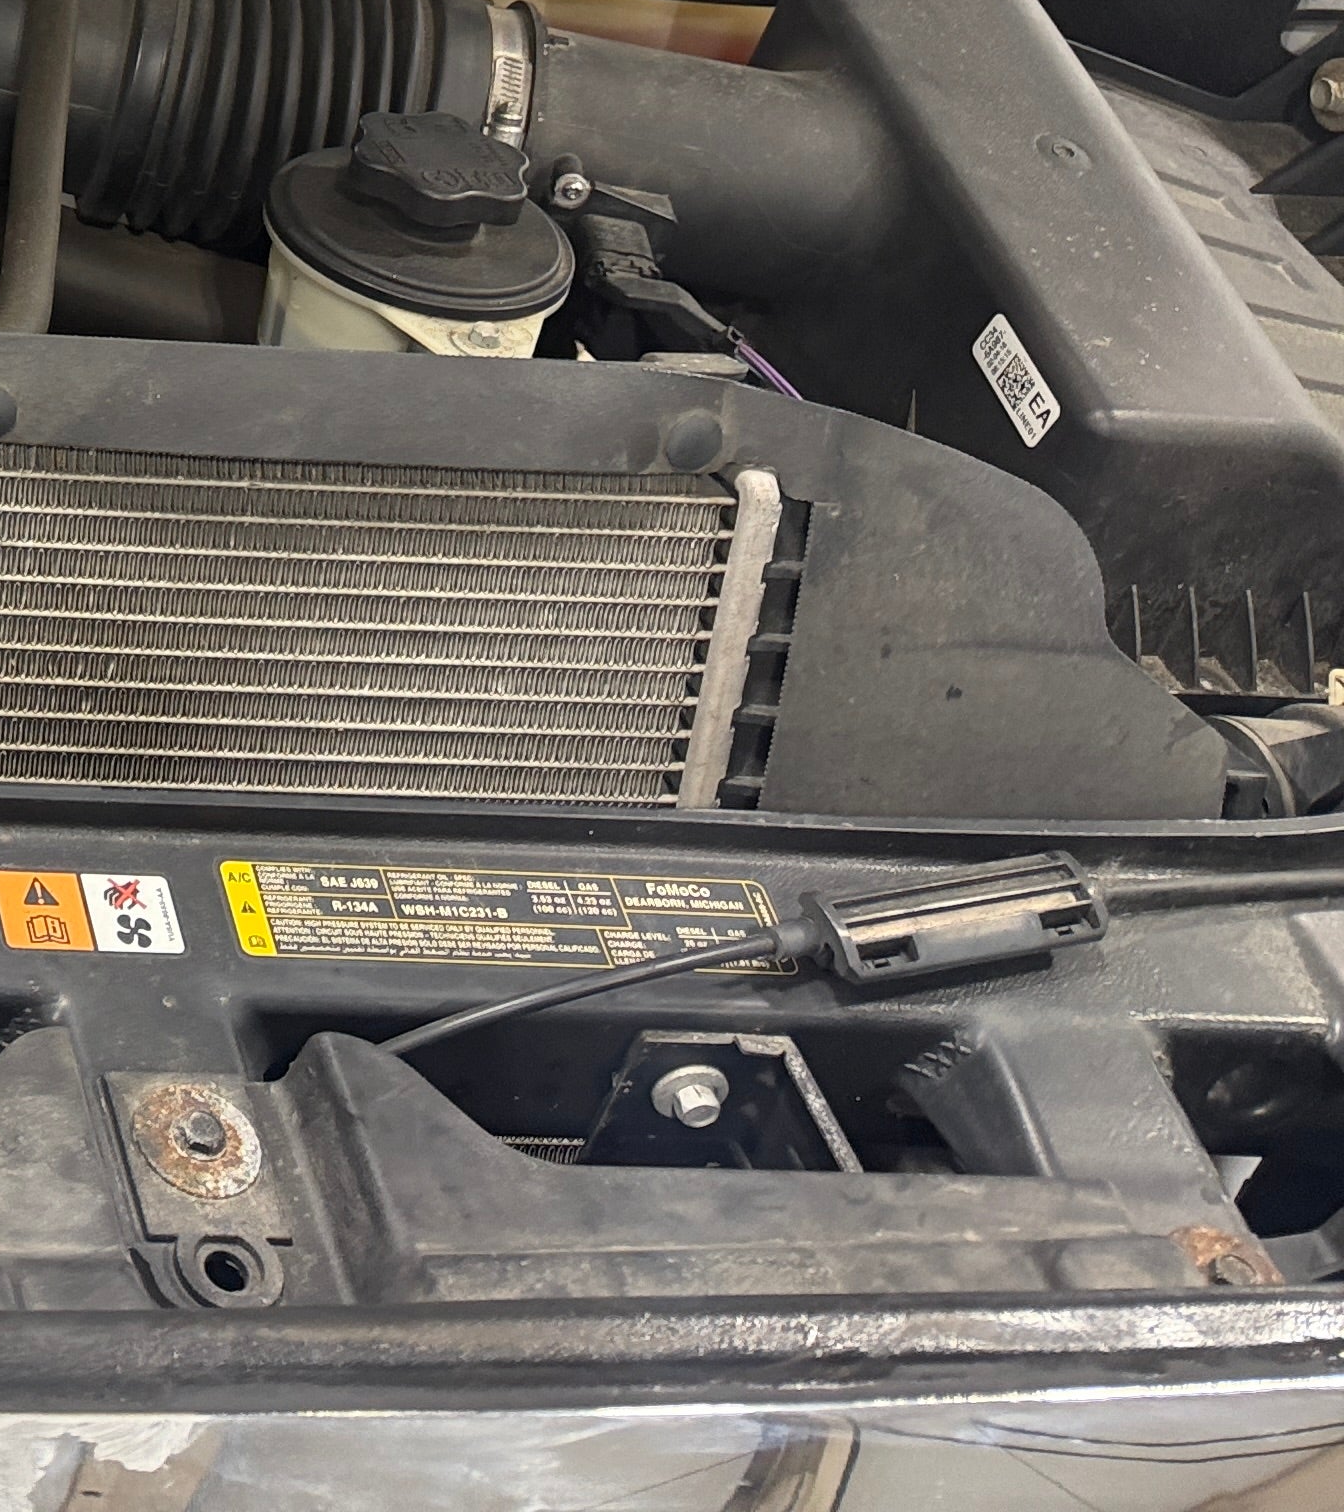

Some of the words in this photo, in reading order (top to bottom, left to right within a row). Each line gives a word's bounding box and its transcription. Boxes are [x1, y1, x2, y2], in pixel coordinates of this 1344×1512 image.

[1029, 391, 1052, 430] EA
[228, 871, 252, 884] A/C
[320, 876, 347, 888] SAE
[350, 877, 377, 889] J639
[527, 880, 561, 890] DIESEL
[578, 882, 599, 891] GAS
[645, 882, 711, 898] FoMoCo
[331, 900, 379, 913] R-134A
[554, 896, 566, 904] oz
[599, 898, 612, 906] oz
[624, 897, 688, 908] DEARBORN,
[690, 899, 743, 910] MICHIGAN
[401, 904, 508, 919] WSH-M1C231-B
[676, 927, 707, 936] DIESEL
[727, 929, 746, 938] GAS
